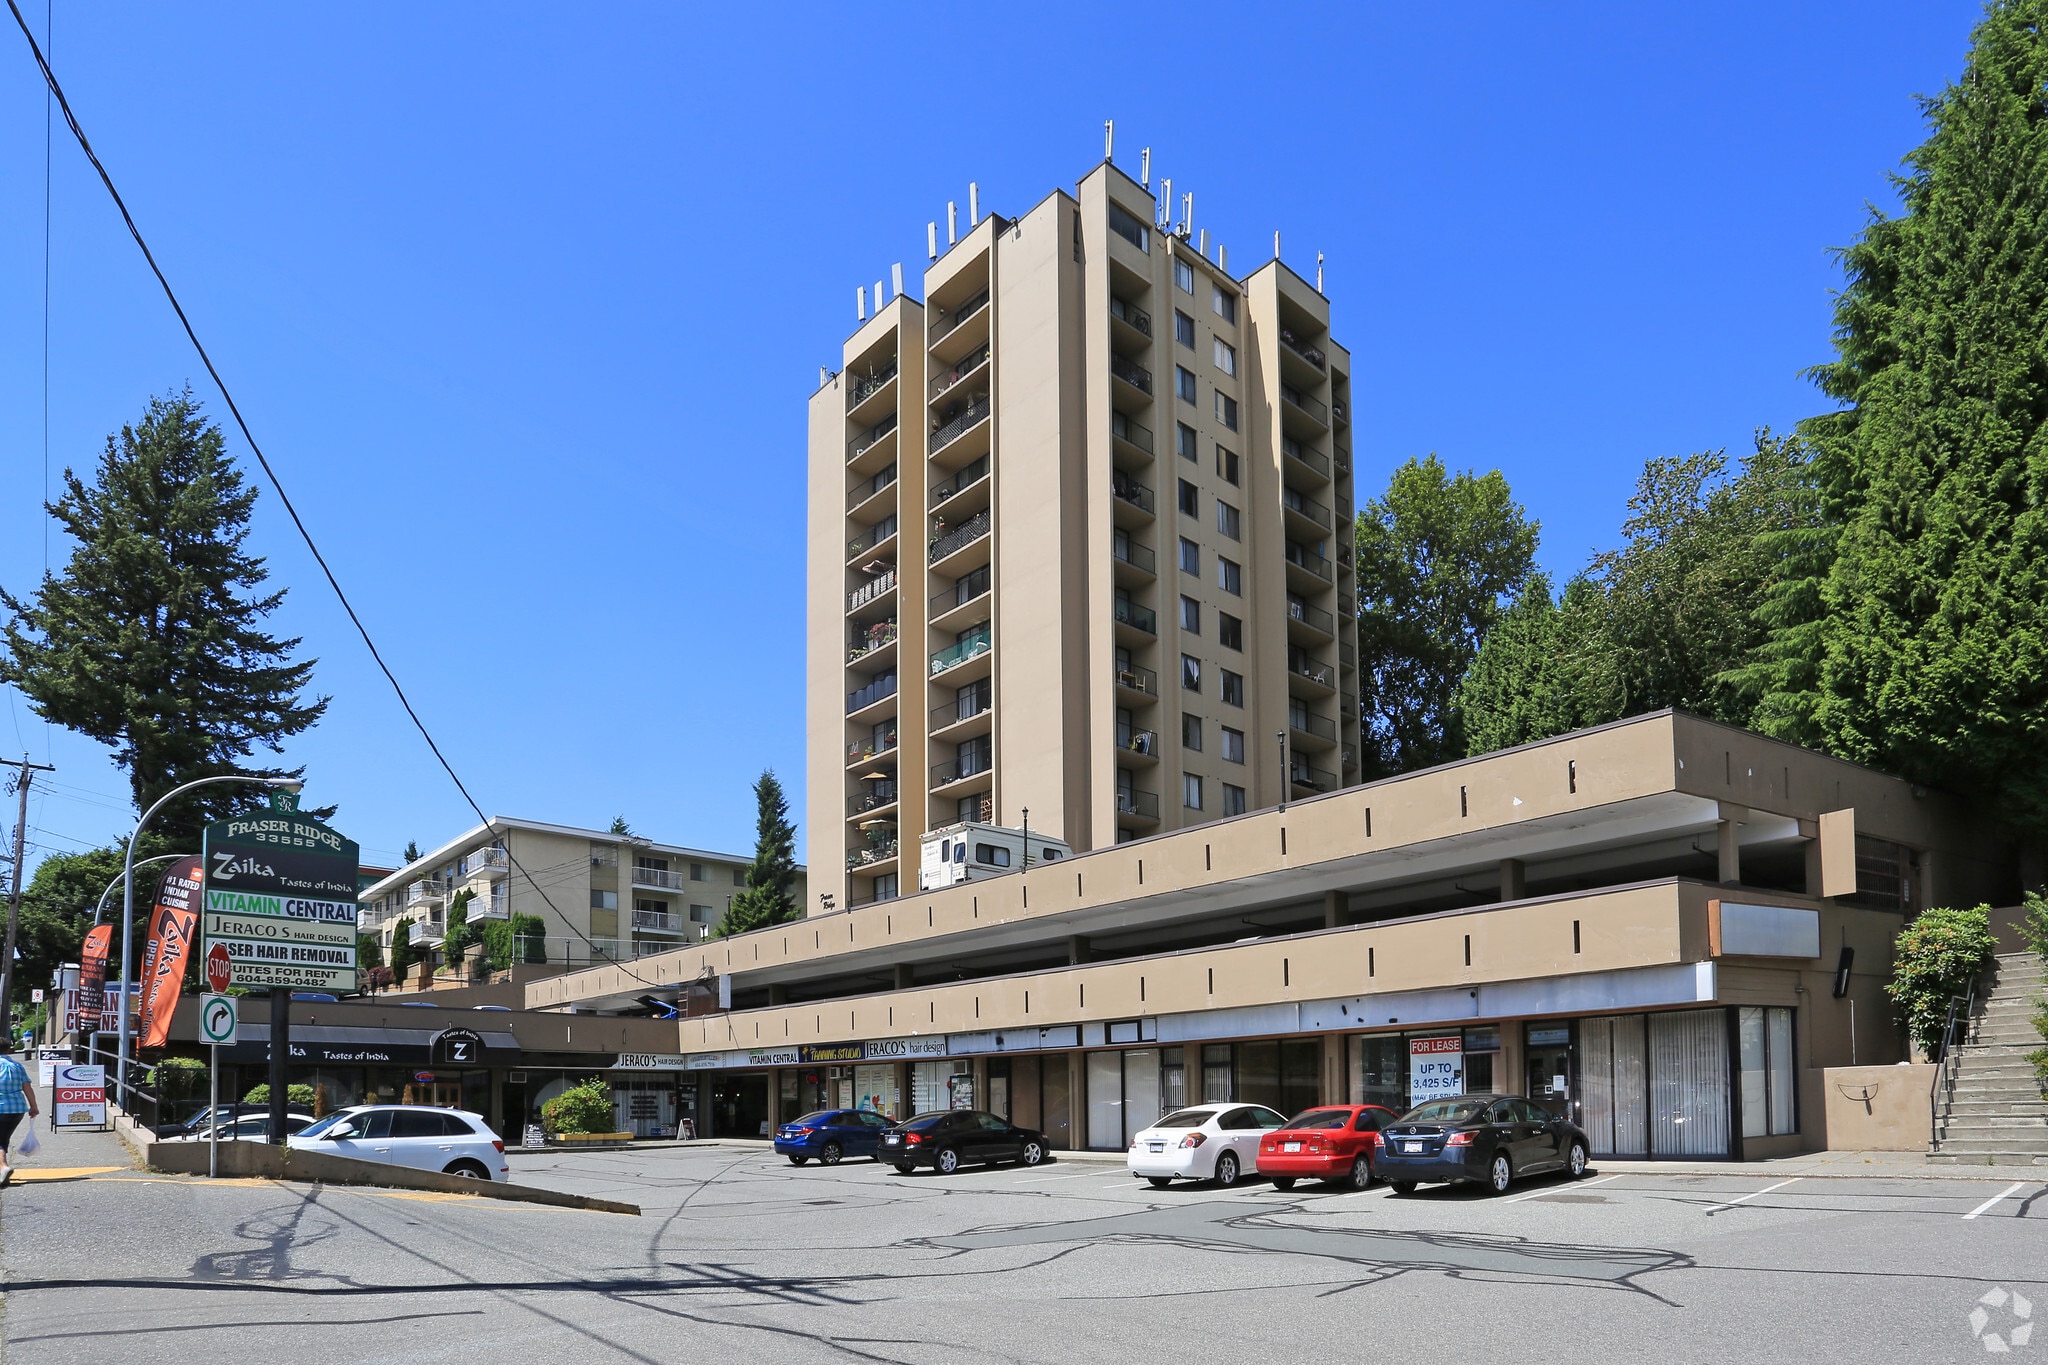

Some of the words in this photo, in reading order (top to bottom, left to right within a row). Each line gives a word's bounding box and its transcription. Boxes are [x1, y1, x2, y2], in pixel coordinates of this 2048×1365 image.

[227, 820, 290, 838] FRASER
[294, 823, 342, 852] RIDGE
[256, 833, 316, 848] 33555
[212, 851, 276, 880] Zaika
[166, 876, 176, 885] #1
[178, 878, 200, 891] RATED
[280, 877, 312, 889] Tastes
[315, 880, 326, 889] of
[327, 882, 353, 893] India
[164, 886, 189, 899] INDIAN
[161, 896, 190, 910] CUISINE
[209, 891, 281, 915] VITAMIN
[286, 899, 354, 922] CENTRAL
[156, 907, 195, 976] Zaika
[294, 932, 315, 941] HAIR
[317, 934, 349, 943] DESIGN
[145, 939, 159, 967] OPEN
[212, 941, 253, 957] SER
[257, 944, 288, 960] HAIR
[291, 947, 349, 964] REMOVAL
[209, 957, 230, 979] STOP
[230, 964, 271, 975] UITES
[275, 967, 301, 978] FOR
[305, 970, 339, 979] RENT
[236, 974, 327, 987] 604-859-0482
[454, 1042, 467, 1060] Z
[838, 1047, 861, 1059] STUDIO
[866, 1040, 906, 1058] JERACO'S
[909, 1042, 922, 1054] hair
[923, 1041, 945, 1056] design
[1412, 1041, 1430, 1052] FOR
[1431, 1040, 1460, 1051] LEASE
[323, 1051, 353, 1060] Tastes
[354, 1051, 365, 1060] of
[366, 1052, 389, 1061] India
[621, 1054, 657, 1067] JERACO'S
[749, 1055, 772, 1065] VITAMIN
[773, 1053, 798, 1063] CENTRAL
[1420, 1064, 1435, 1074] UP
[1437, 1063, 1452, 1073] TO
[1413, 1078, 1440, 1089] 3,425
[1442, 1077, 1459, 1088] S/F
[61, 1090, 101, 1100] OPEN
